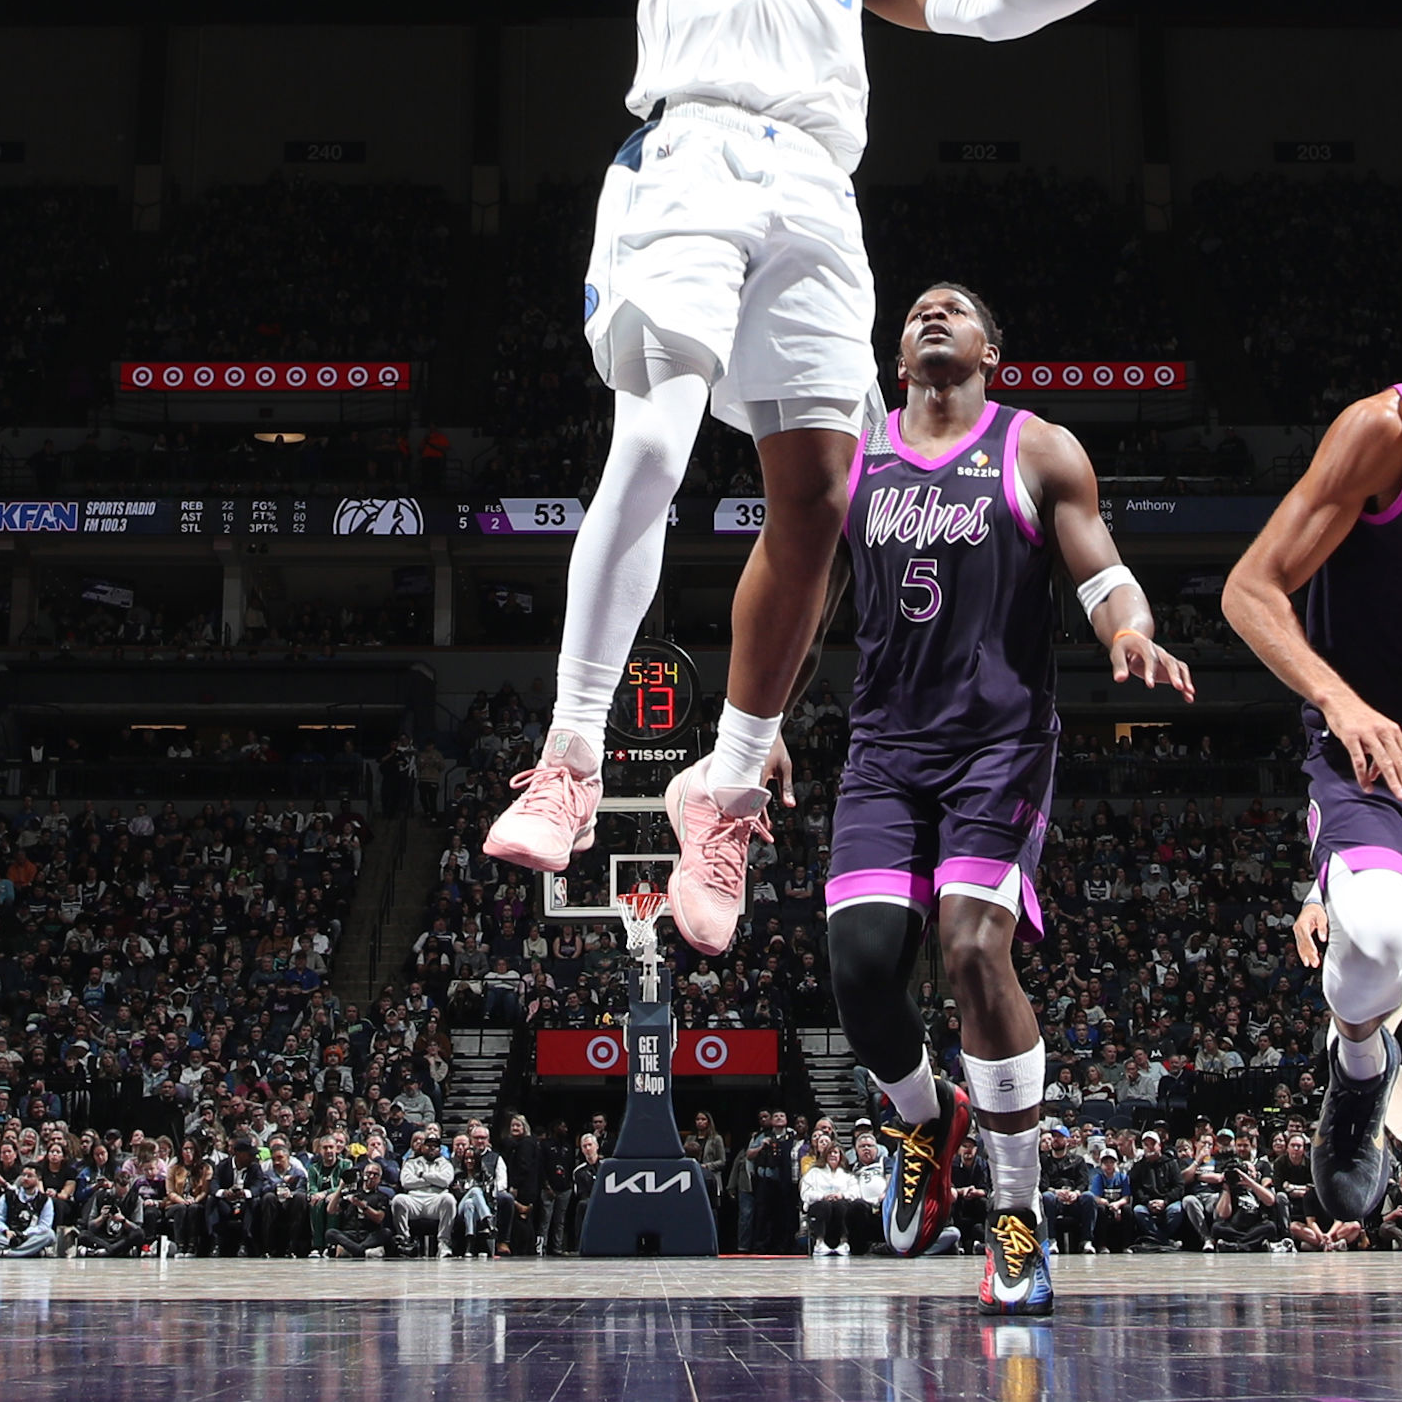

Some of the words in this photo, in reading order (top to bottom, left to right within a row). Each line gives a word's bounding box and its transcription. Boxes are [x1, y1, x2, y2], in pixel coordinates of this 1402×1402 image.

[307, 144, 343, 160] 240
[961, 144, 997, 160] 202
[1296, 144, 1332, 160] 203
[957, 465, 1001, 478] sezzle
[84, 501, 124, 516] SPORTS
[124, 501, 157, 516] RADIO
[180, 501, 204, 511] REB
[221, 501, 235, 511] 22
[251, 501, 278, 511] FG%
[456, 504, 470, 514] TO
[484, 504, 502, 514] FLS
[1125, 499, 1176, 514] Anthony
[180, 512, 203, 522] AST
[222, 512, 234, 523] 16
[252, 512, 276, 521] FT%
[292, 512, 306, 523] 60
[533, 504, 567, 526] 53
[735, 504, 765, 526] 39
[865, 484, 993, 550] Wolves
[83, 517, 99, 533] FM
[100, 517, 128, 533] 100.3
[180, 523, 202, 533] STL
[223, 524, 231, 534] 2
[248, 523, 279, 533] 3PT%
[292, 523, 305, 533] 52
[458, 517, 468, 530] 5
[490, 517, 500, 530] 2
[899, 557, 943, 623] 5
[628, 661, 679, 685] 5:34
[636, 686, 675, 729] 13
[628, 749, 687, 761] TISSOT
[638, 1036, 659, 1054] GET
[639, 1055, 660, 1072] THE
[644, 1073, 665, 1096] App
[999, 1079, 1014, 1092] 5
[605, 1170, 692, 1194] KIA
